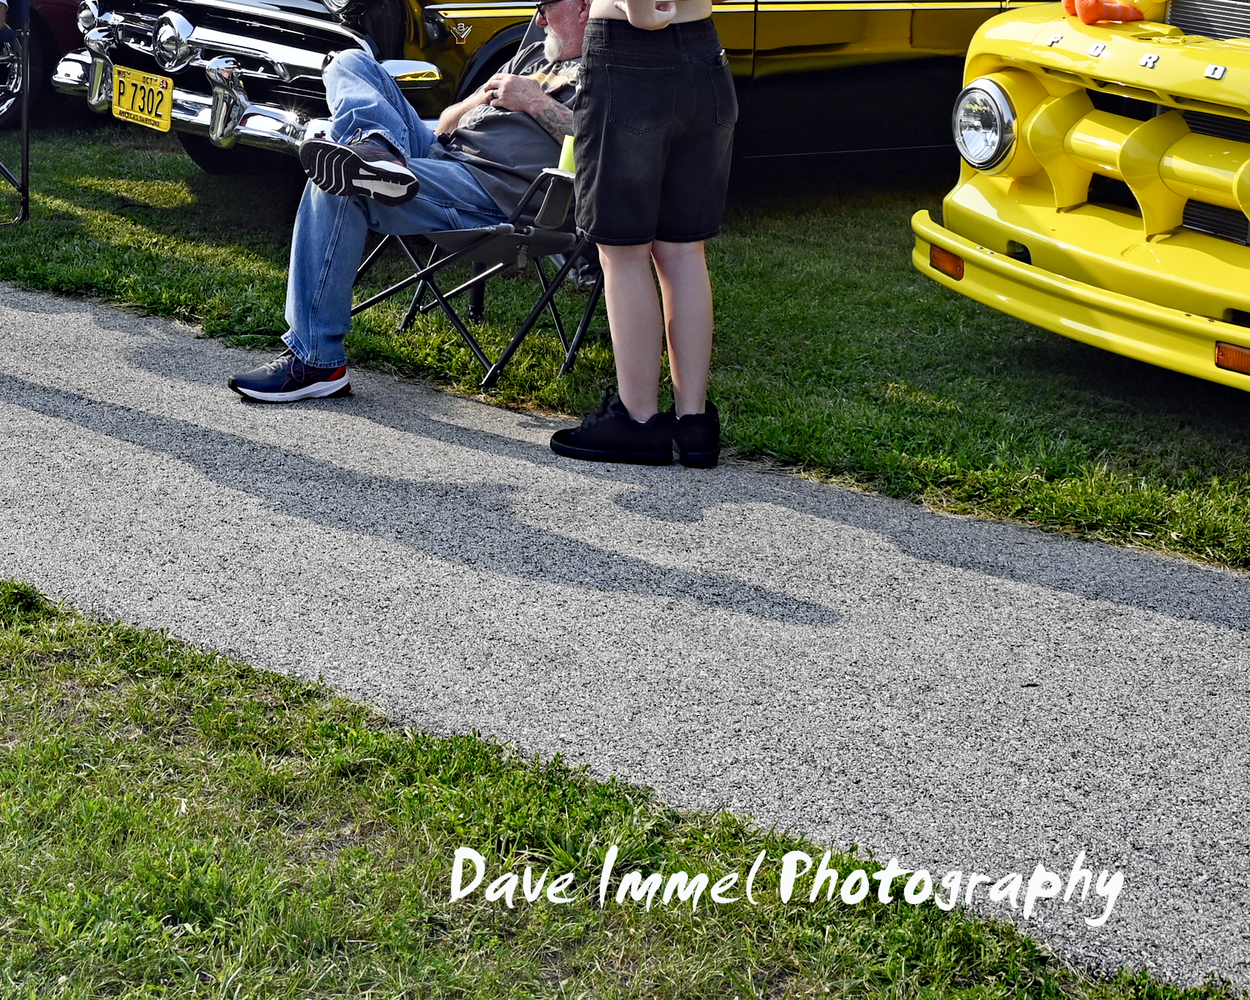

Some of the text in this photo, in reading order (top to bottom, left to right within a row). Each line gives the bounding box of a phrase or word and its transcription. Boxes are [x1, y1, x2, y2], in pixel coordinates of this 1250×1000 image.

[117, 70, 126, 78] WIS
[143, 76, 153, 84] OCT
[1047, 33, 1227, 81] FORD
[118, 78, 164, 118] P 7302
